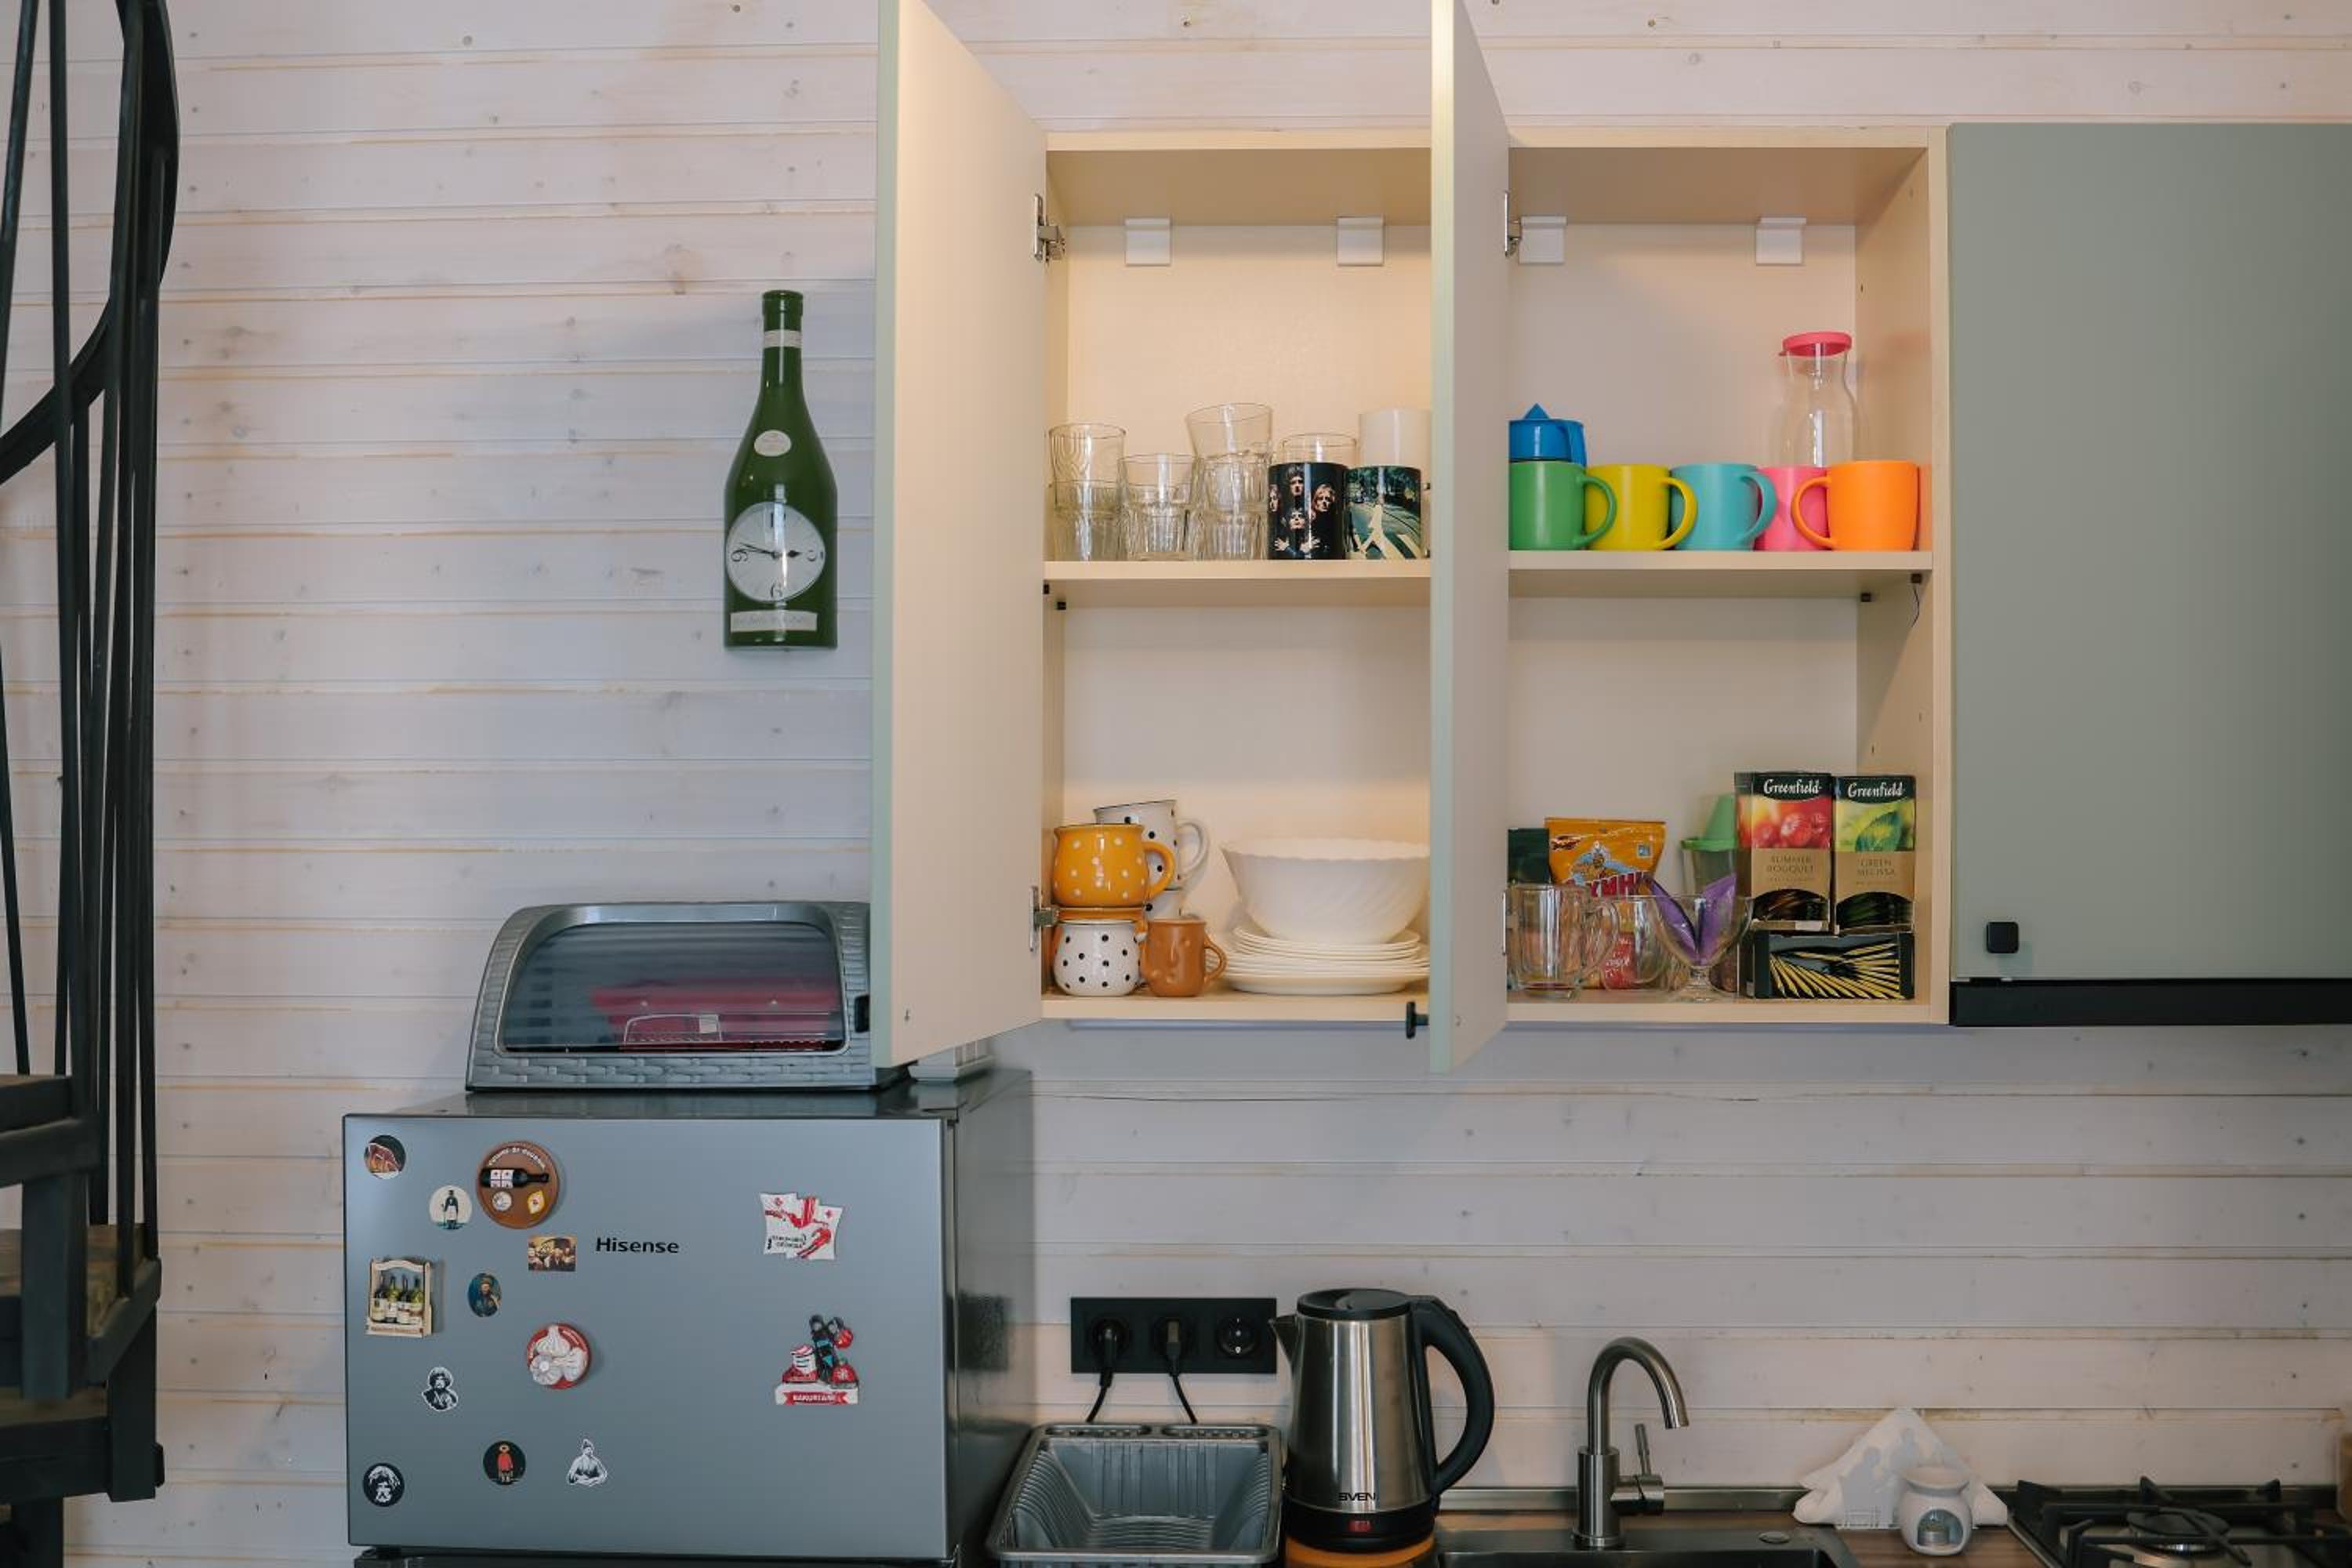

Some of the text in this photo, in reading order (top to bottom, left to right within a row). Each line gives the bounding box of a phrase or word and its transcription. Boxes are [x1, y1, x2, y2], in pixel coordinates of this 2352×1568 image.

[731, 549, 749, 562] 9
[1764, 779, 1820, 795] Greenfield
[1848, 782, 1903, 798] Greenfield
[1766, 865, 1814, 873] BOUQUET
[1859, 858, 1893, 867] GREEN
[595, 1237, 680, 1254] Hisense
[1338, 1492, 1376, 1501] SVEN
